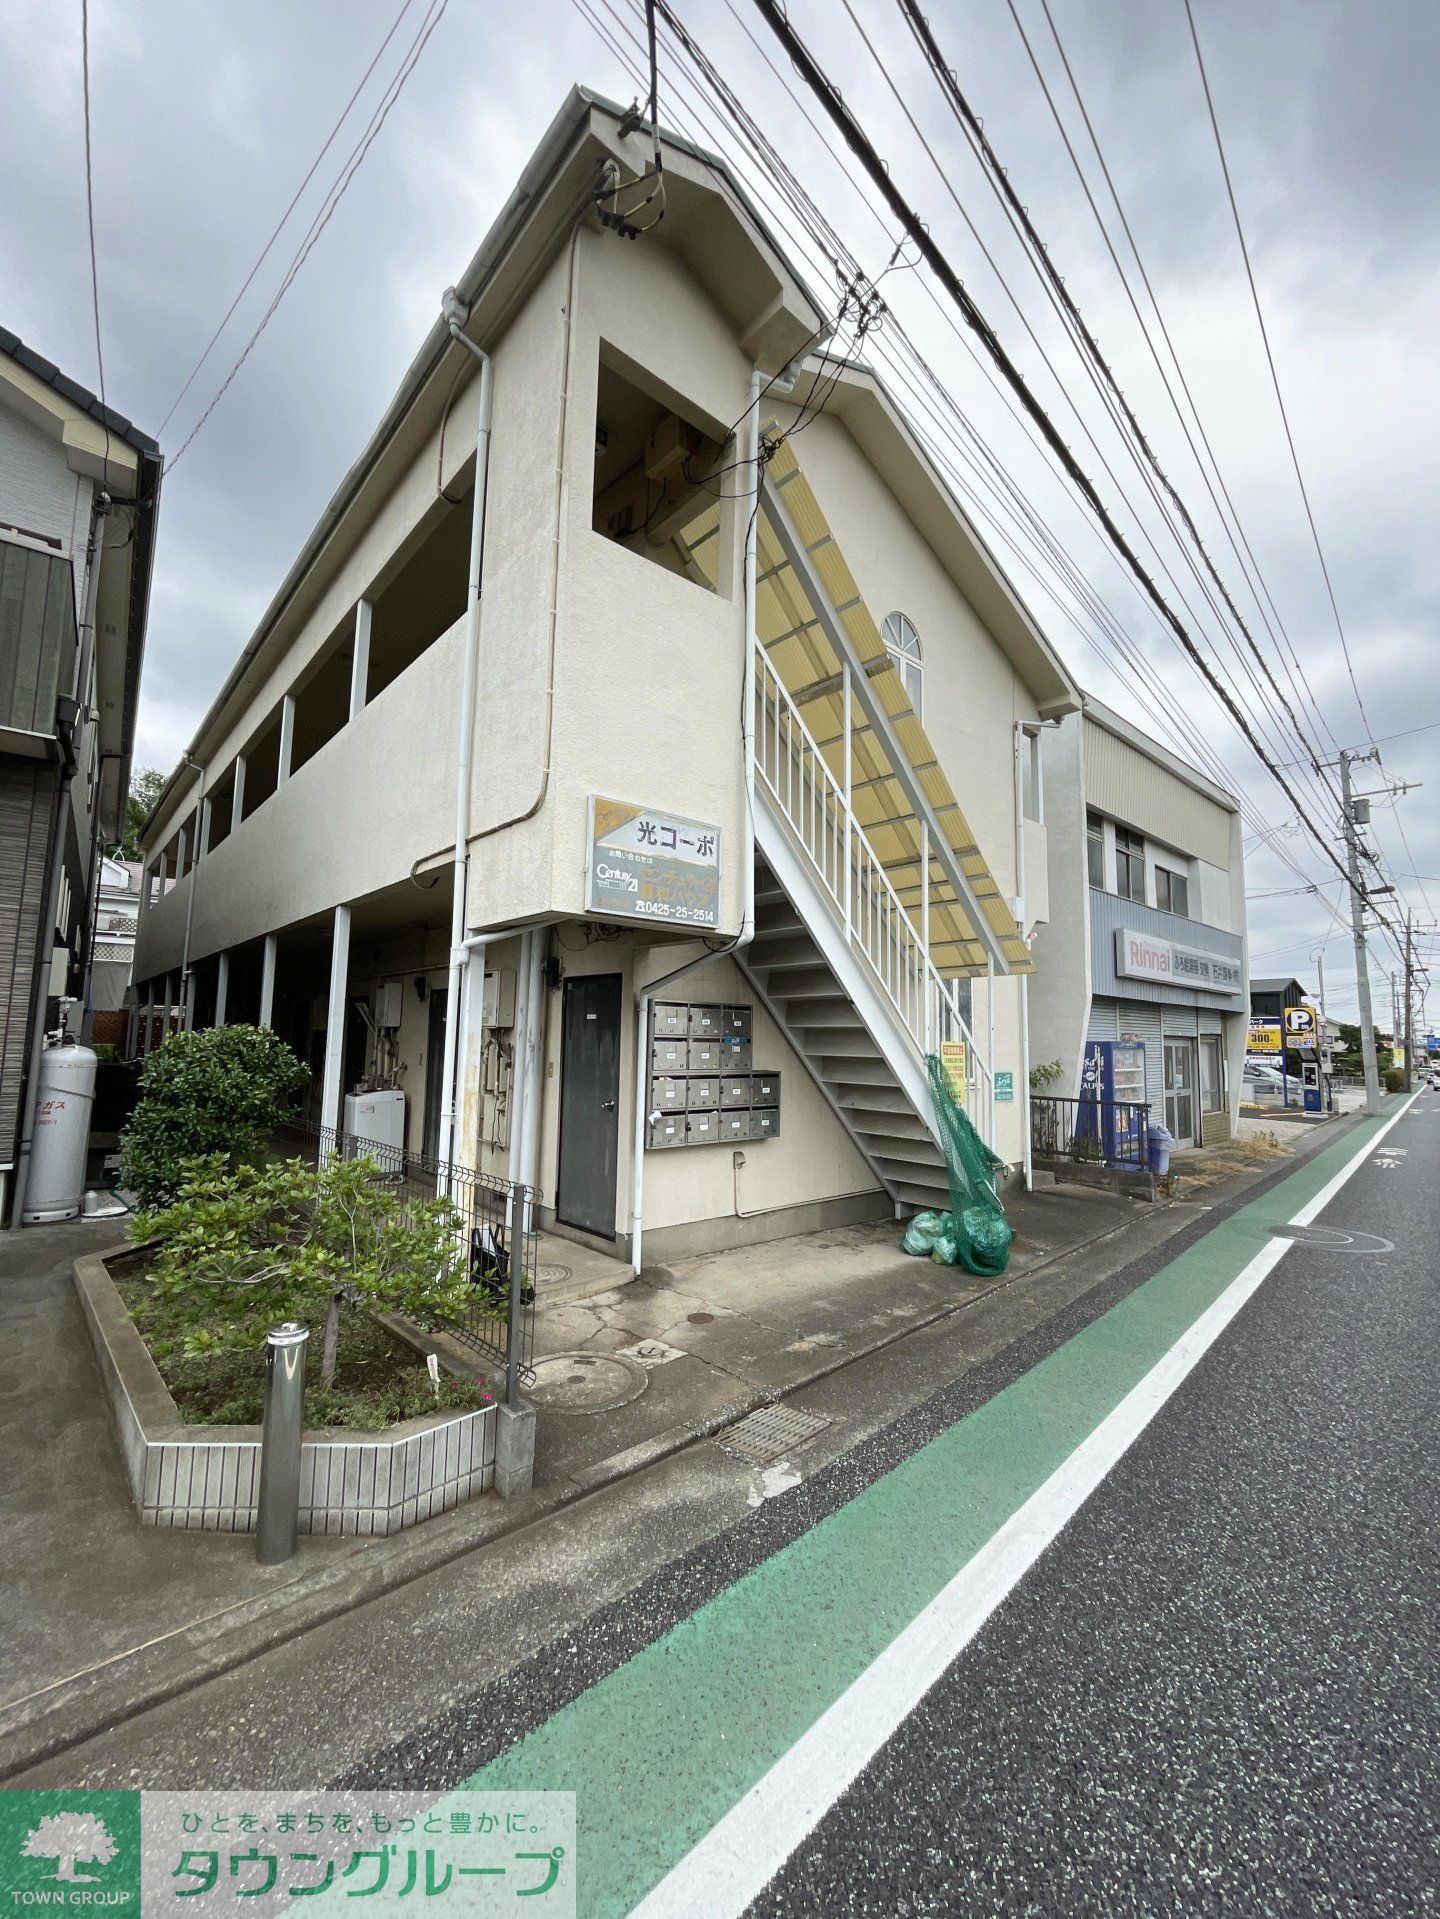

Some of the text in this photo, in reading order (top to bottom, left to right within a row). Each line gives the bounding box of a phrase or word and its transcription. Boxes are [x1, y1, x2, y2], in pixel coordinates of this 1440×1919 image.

[637, 821, 715, 858] 光コーポ
[596, 863, 639, 893] Century 21
[645, 901, 714, 922] 0425-25-2514
[1130, 940, 1170, 973] Rinnai
[1291, 1010, 1310, 1029] P
